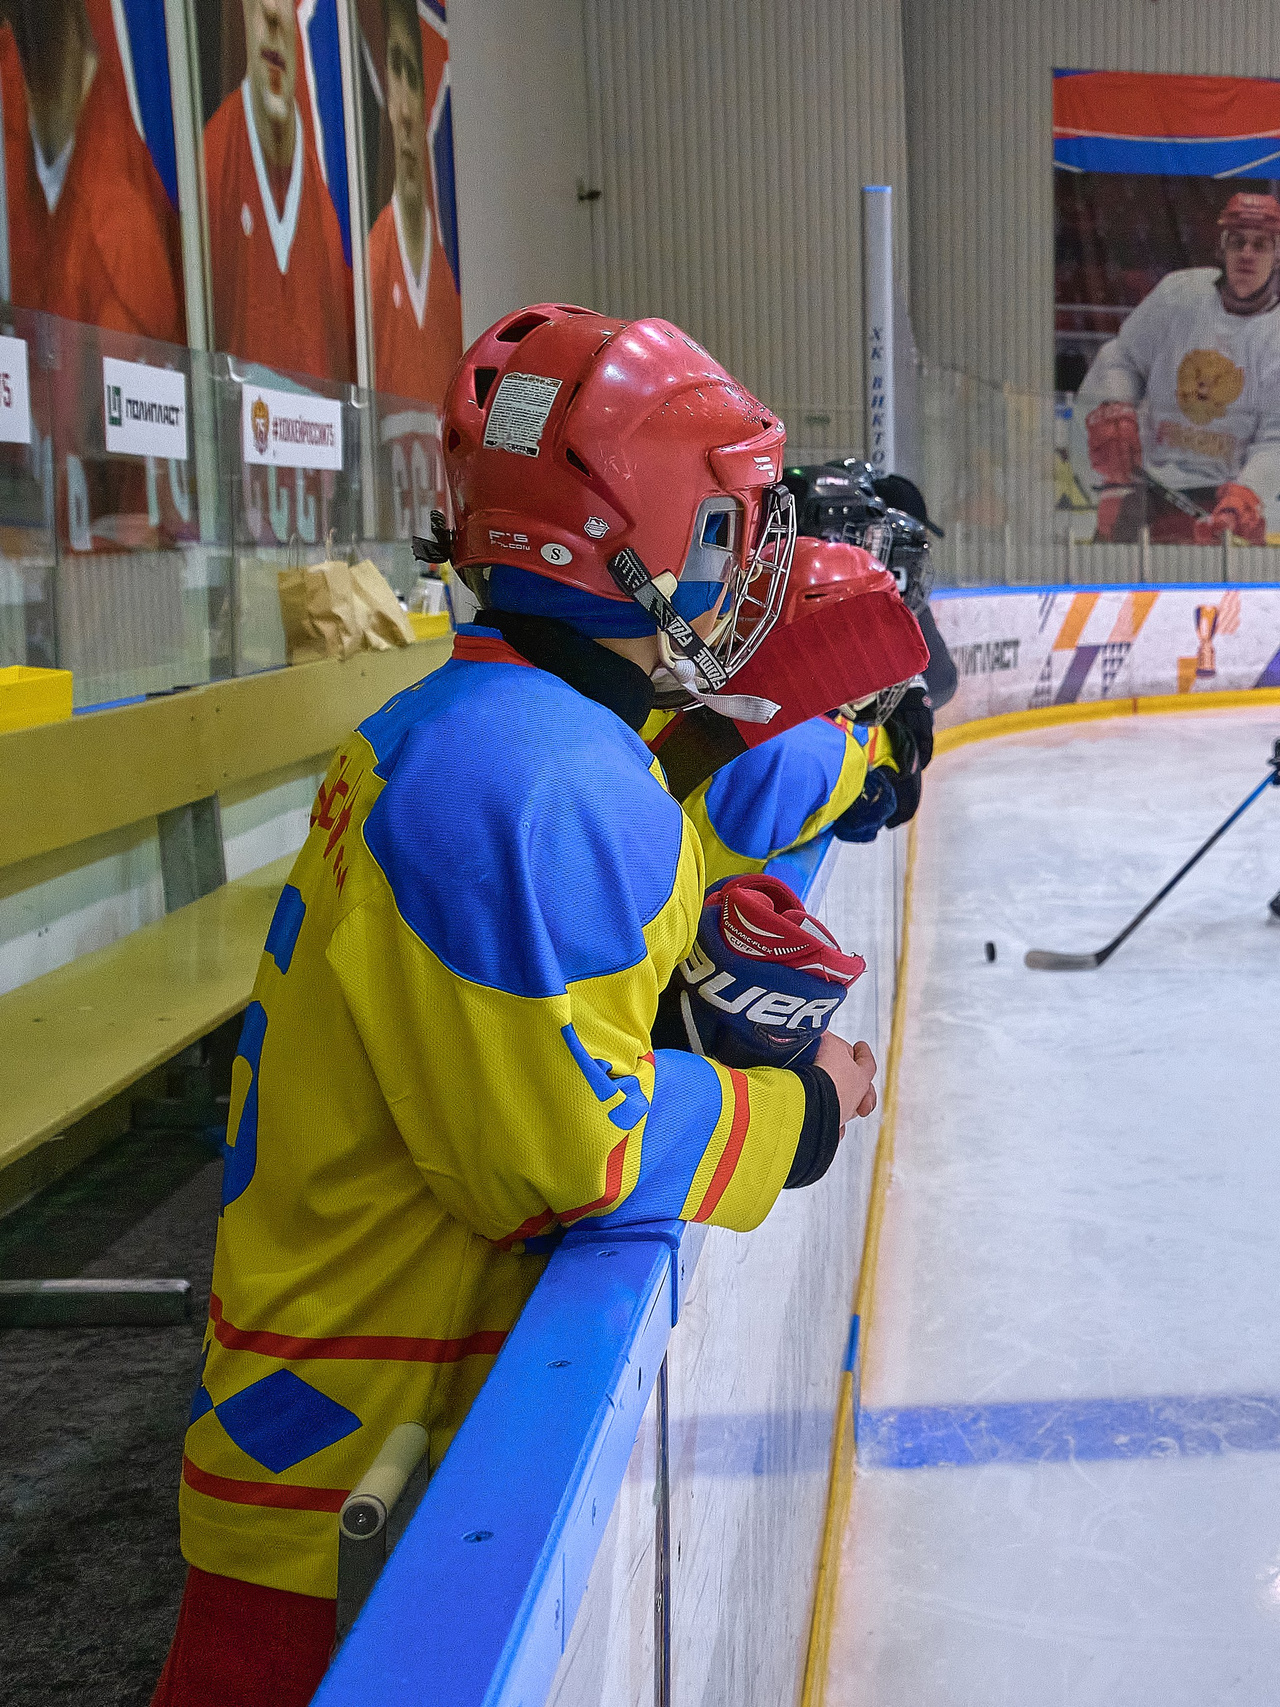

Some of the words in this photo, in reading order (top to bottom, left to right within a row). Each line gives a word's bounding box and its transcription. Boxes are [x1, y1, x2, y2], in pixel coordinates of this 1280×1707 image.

[0, 372, 11, 408] 5
[125, 398, 180, 426] ПОЛИПЛАСТ
[550, 547, 561, 561] S
[693, 646, 730, 691] FLAME
[678, 941, 840, 1031] AUER
